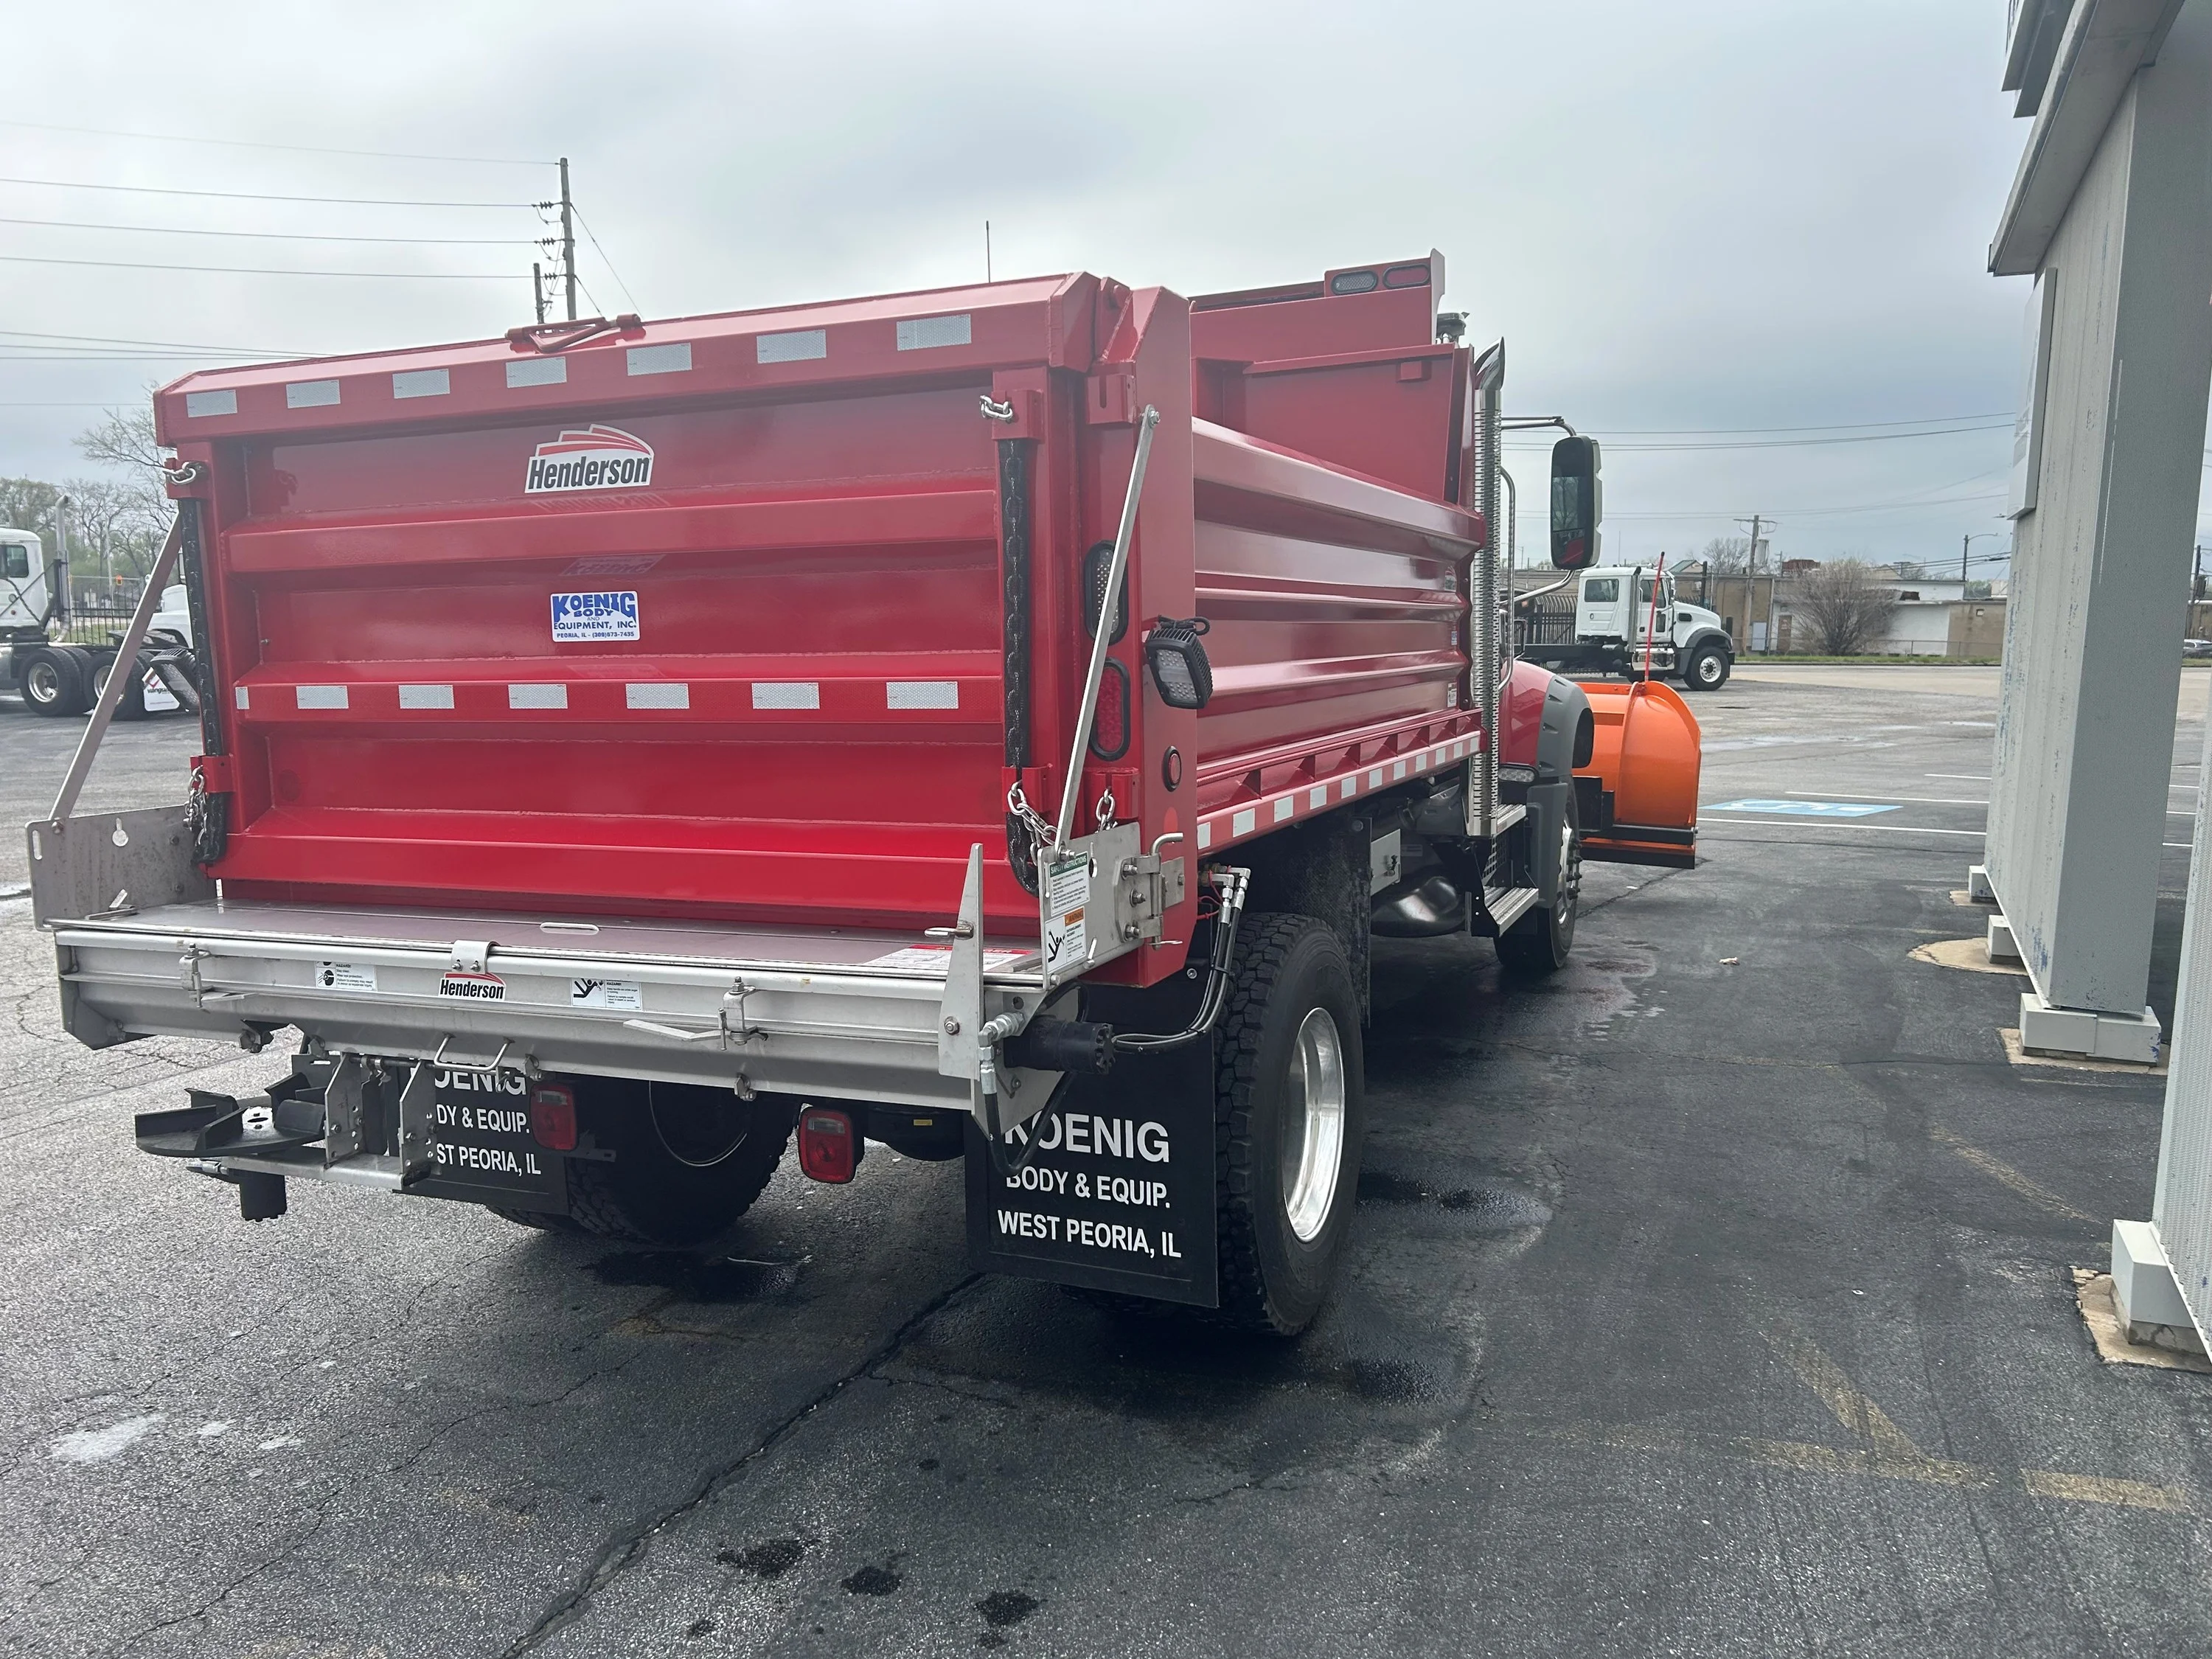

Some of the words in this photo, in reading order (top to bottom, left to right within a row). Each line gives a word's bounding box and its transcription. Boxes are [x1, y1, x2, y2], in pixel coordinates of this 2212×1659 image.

[529, 456, 650, 490] Henderson
[552, 593, 637, 623] KOENIG
[574, 608, 613, 617] BODY
[554, 622, 612, 630] EQUIPMENT,
[440, 979, 504, 999] Henderson
[437, 1105, 457, 1126] DY
[462, 1107, 473, 1128] &
[477, 1108, 530, 1133] EQUIP.
[437, 1143, 454, 1165] ST
[459, 1146, 522, 1177] PEORIA,
[526, 1153, 541, 1175] IL
[1006, 1166, 1068, 1194] BODY
[1074, 1172, 1091, 1198] &
[1097, 1175, 1170, 1208] EQUIP.
[998, 1209, 1060, 1240] WEST
[1067, 1218, 1155, 1258] PEORIA,
[1162, 1231, 1182, 1258] IL
